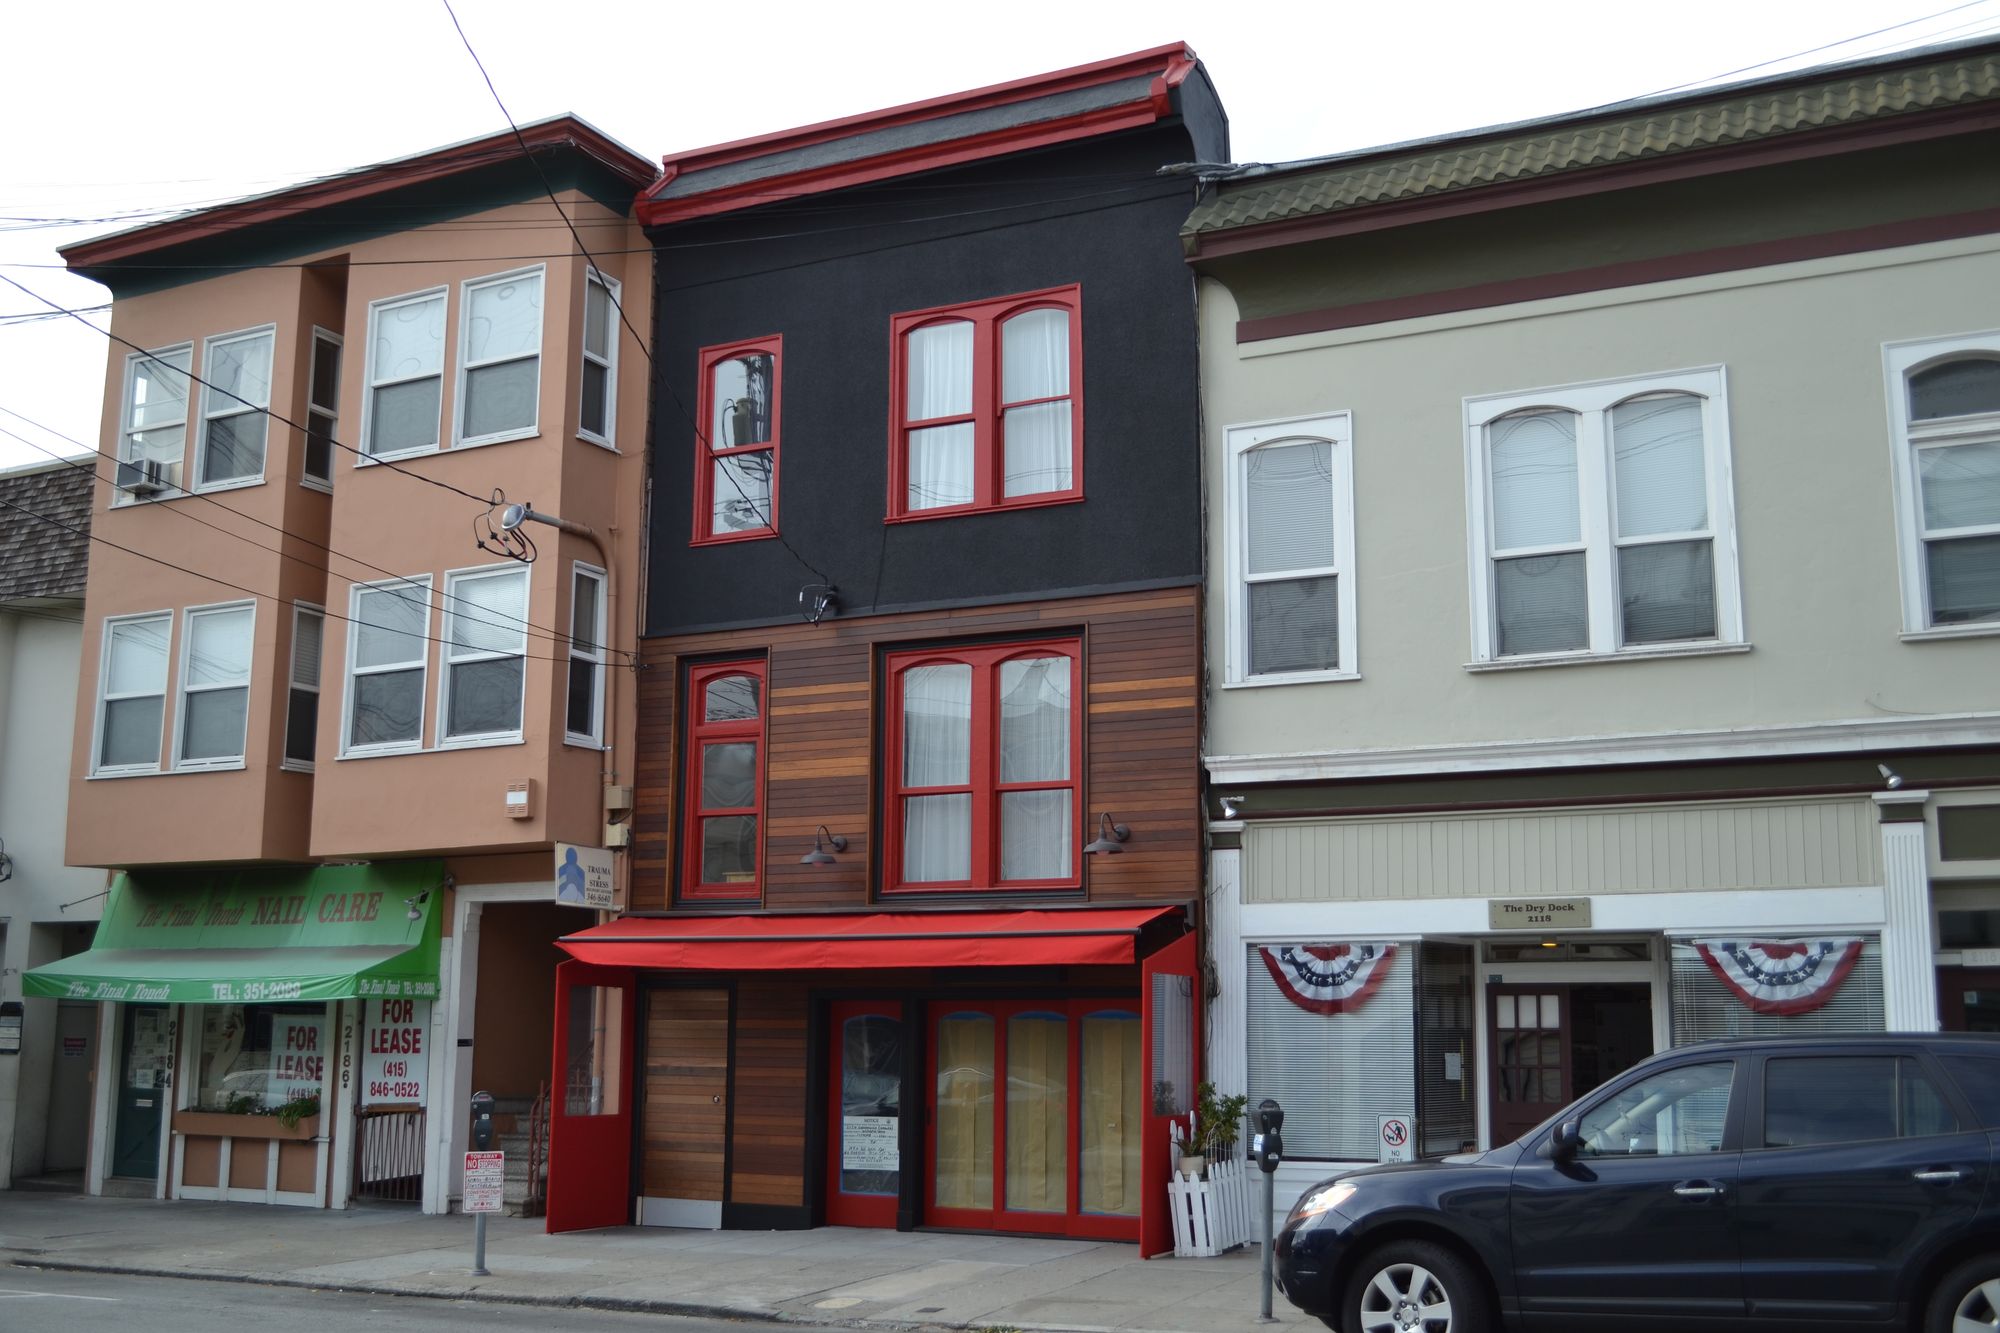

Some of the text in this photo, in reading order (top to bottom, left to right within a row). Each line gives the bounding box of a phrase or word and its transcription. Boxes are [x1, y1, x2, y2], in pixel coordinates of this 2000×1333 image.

[588, 866, 610, 875] TRAUMA
[589, 879, 609, 889] STRESS
[137, 892, 384, 928] The Final Touch NAIL CARE
[1503, 903, 1576, 914] The Dry Dock
[1527, 914, 1552, 923] 2118
[66, 981, 171, 1000] The Final Touch
[212, 983, 240, 1000] TEL:
[381, 999, 414, 1024] FOR
[286, 1025, 318, 1051] FOR
[370, 1028, 422, 1054] LEASE
[276, 1054, 324, 1081] LEASE
[383, 1060, 408, 1078] (415)
[370, 1081, 420, 1098] 846-0522
[1391, 1149, 1401, 1157] NO
[467, 1160, 501, 1168] NO STOPPING
